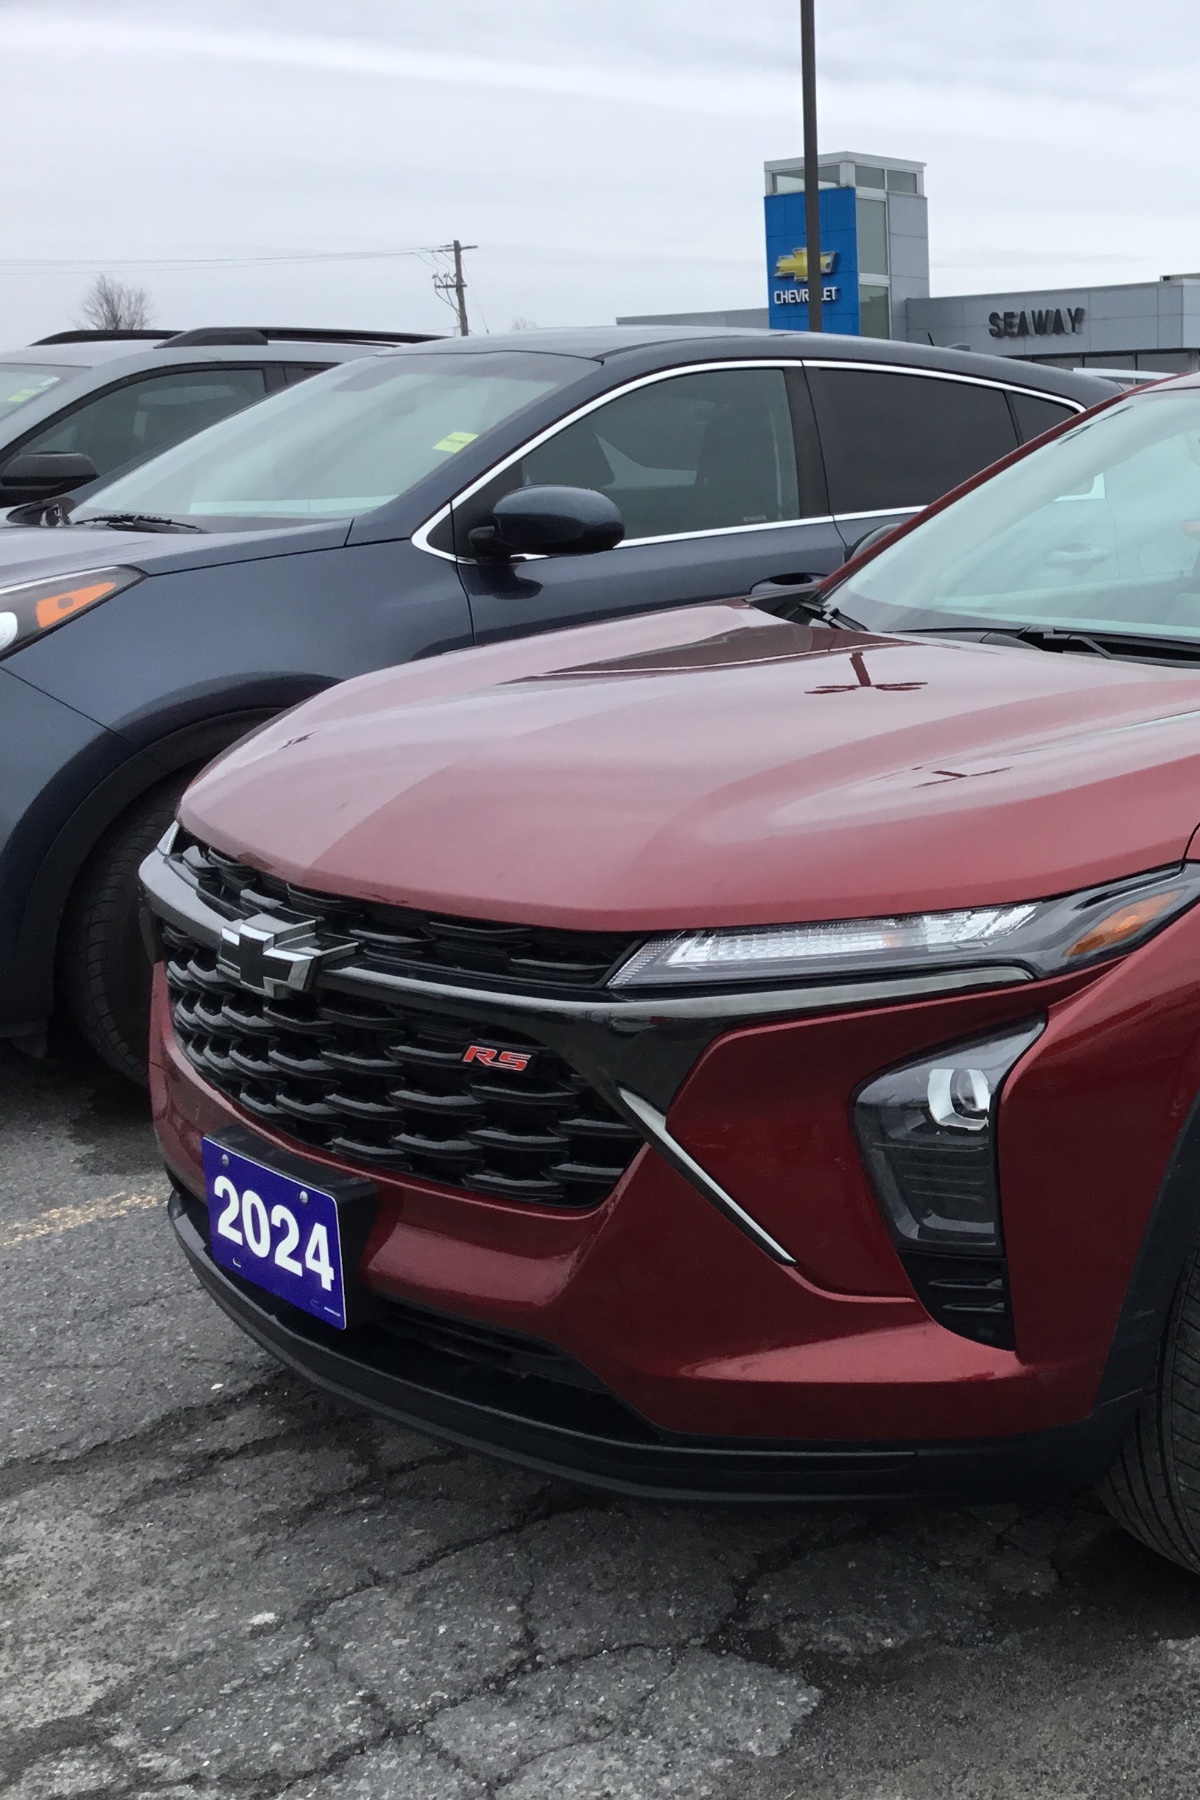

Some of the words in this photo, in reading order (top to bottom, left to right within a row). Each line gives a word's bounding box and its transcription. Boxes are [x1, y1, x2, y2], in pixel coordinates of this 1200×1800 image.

[773, 286, 838, 304] CHEVRET
[988, 307, 1086, 338] SEAWAY
[462, 1045, 532, 1071] RS
[214, 1175, 335, 1292] 2024
